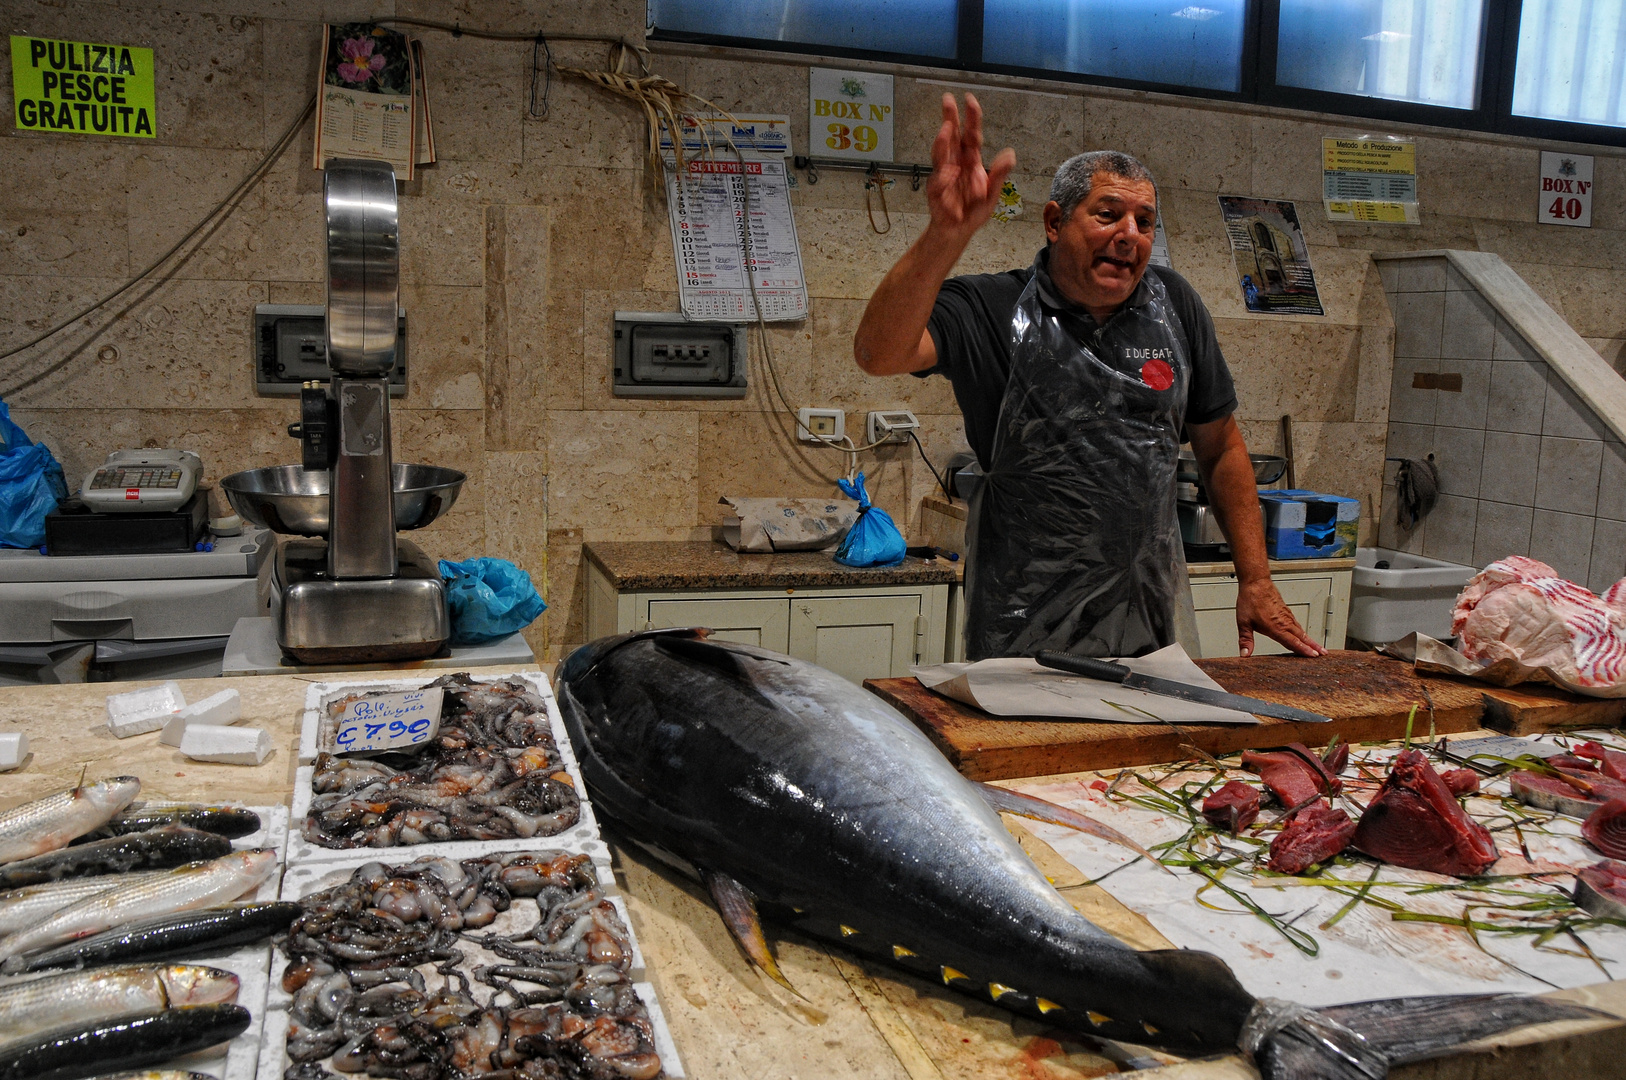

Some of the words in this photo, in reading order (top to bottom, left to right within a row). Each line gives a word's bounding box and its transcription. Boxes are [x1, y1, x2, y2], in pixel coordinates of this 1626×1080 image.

[30, 39, 136, 76] PULIZIA
[42, 71, 127, 104] PESCE
[18, 98, 152, 135] GRATUITA
[814, 98, 863, 120] BOX
[869, 104, 891, 122] N°
[825, 123, 878, 153] 39
[1336, 140, 1359, 150] Metodo
[1362, 142, 1369, 150] di
[1370, 143, 1403, 152] Produzione
[690, 162, 761, 173] SETTEMBRE
[1542, 177, 1574, 193] BOX
[1576, 181, 1592, 195] N°
[1548, 197, 1582, 220] 40
[1125, 348, 1131, 358] I
[1133, 348, 1151, 359] DUE
